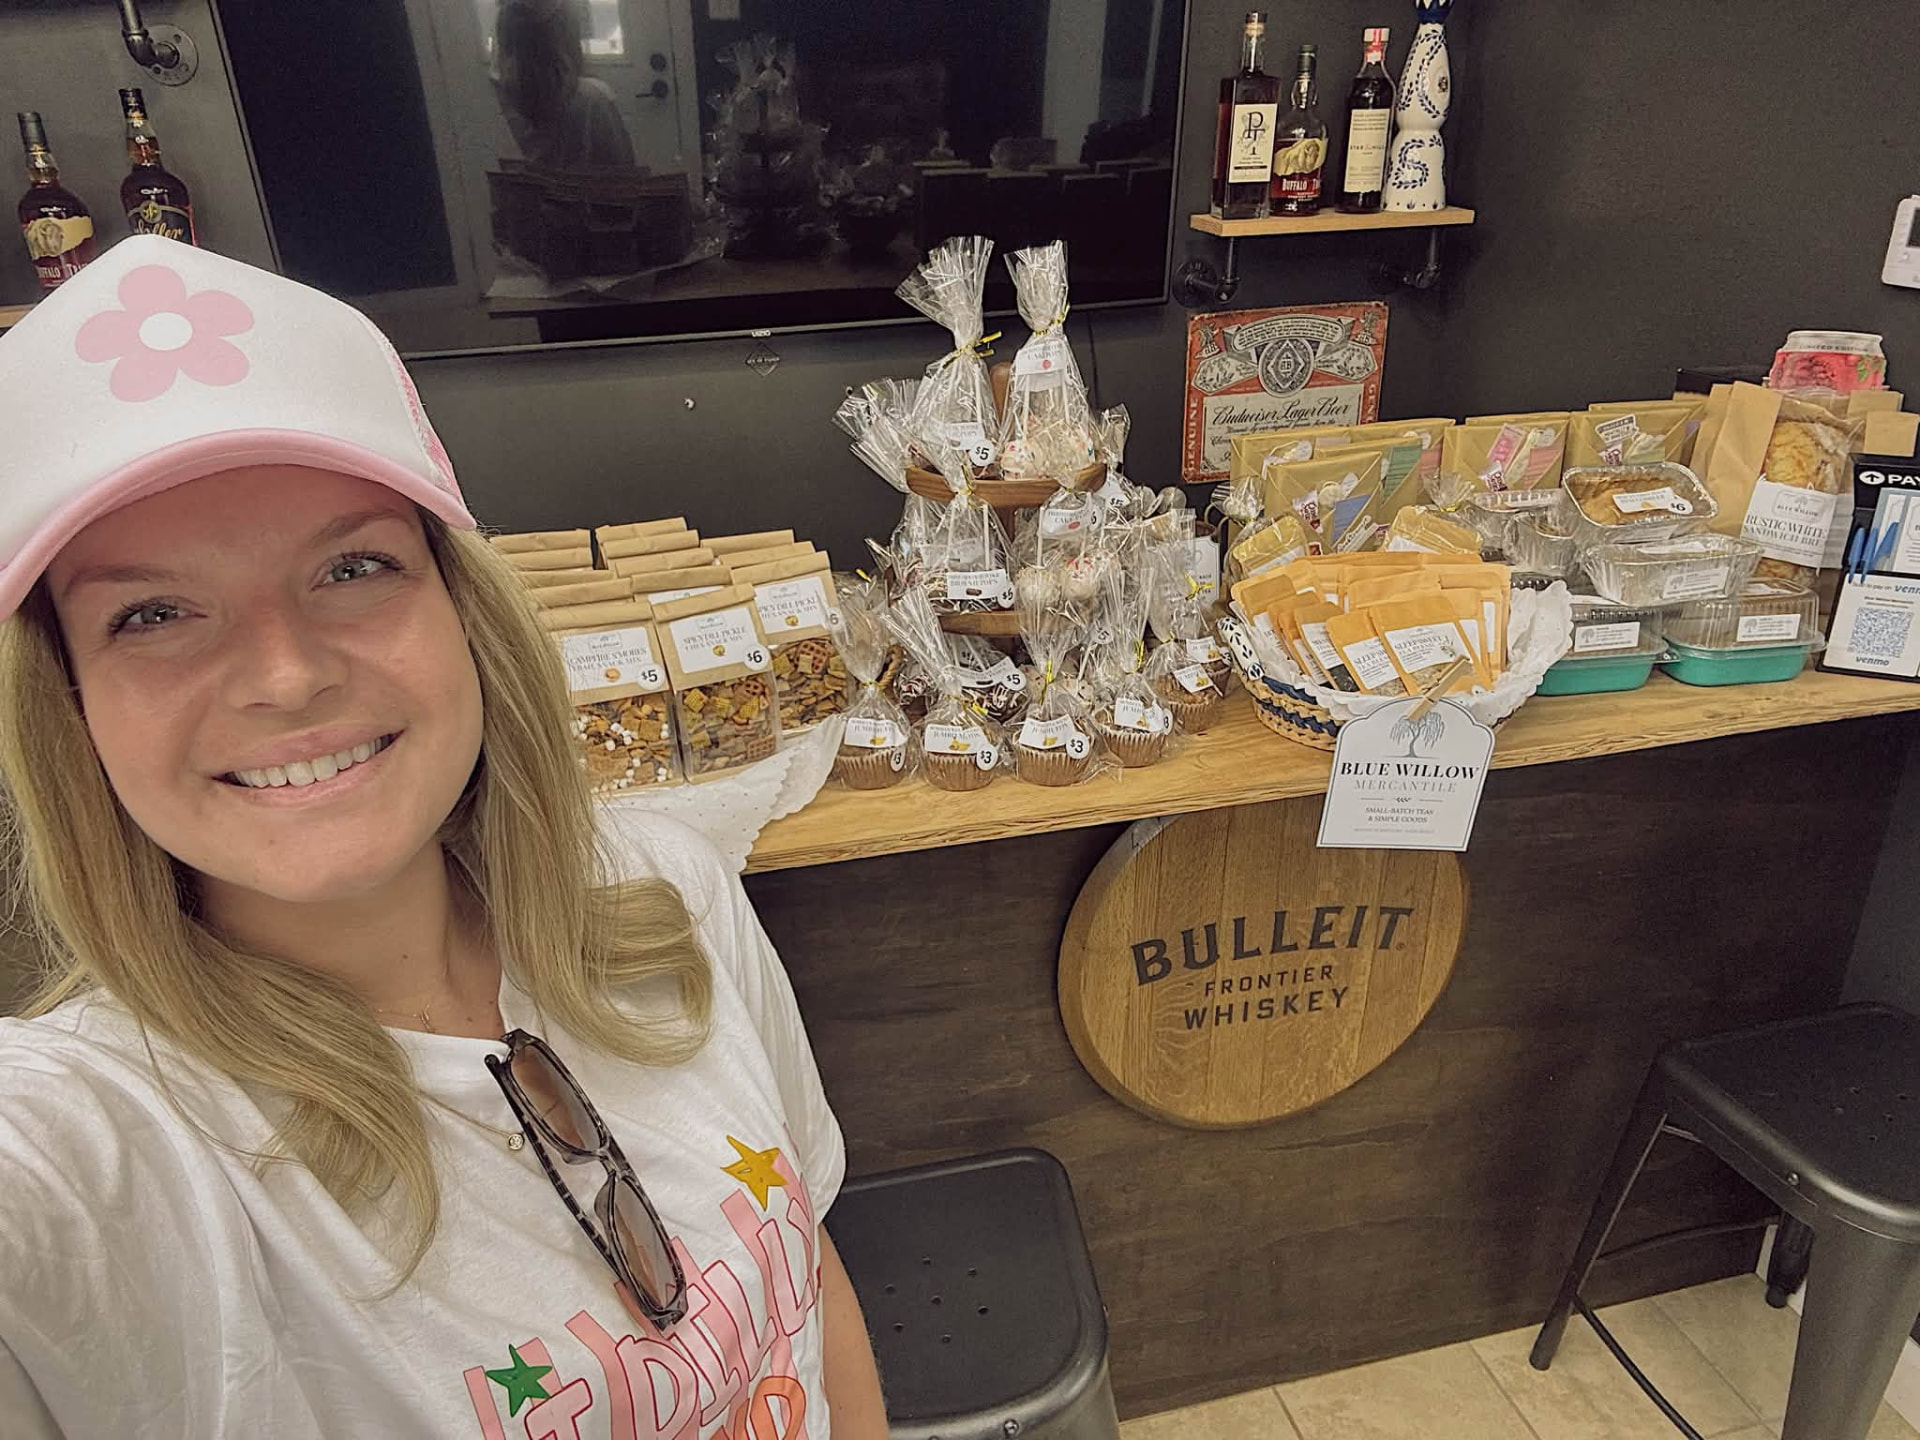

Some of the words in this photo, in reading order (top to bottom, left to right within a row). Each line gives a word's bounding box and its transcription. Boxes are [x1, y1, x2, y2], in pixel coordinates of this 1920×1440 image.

[1282, 178, 1307, 191] BUFFALO
[1212, 405, 1277, 425] Budweiser
[1278, 399, 1317, 421] Lager
[1317, 396, 1351, 416] Beer
[975, 446, 989, 460] $5
[1743, 524, 1799, 543] SANDWICH
[1746, 514, 1787, 532] RUSTIC
[1788, 521, 1828, 539] WHITE
[1894, 585, 1920, 594] ven
[747, 650, 763, 663] $6
[1855, 655, 1890, 667] venmo
[641, 669, 658, 683] $5
[1006, 673, 1021, 685] $5
[1070, 739, 1084, 753] $3
[980, 750, 992, 764] $3
[1340, 762, 1390, 776] BLUE
[1395, 763, 1479, 780] WILLOW
[1353, 779, 1458, 793] MERCANTILE
[1365, 807, 1414, 815] SMALL-BATCH
[1401, 816, 1428, 824] GOODS
[1131, 905, 1415, 986] BULLEIT
[1205, 965, 1333, 996] FRONTIER
[1185, 987, 1348, 1030] WHISKEY
